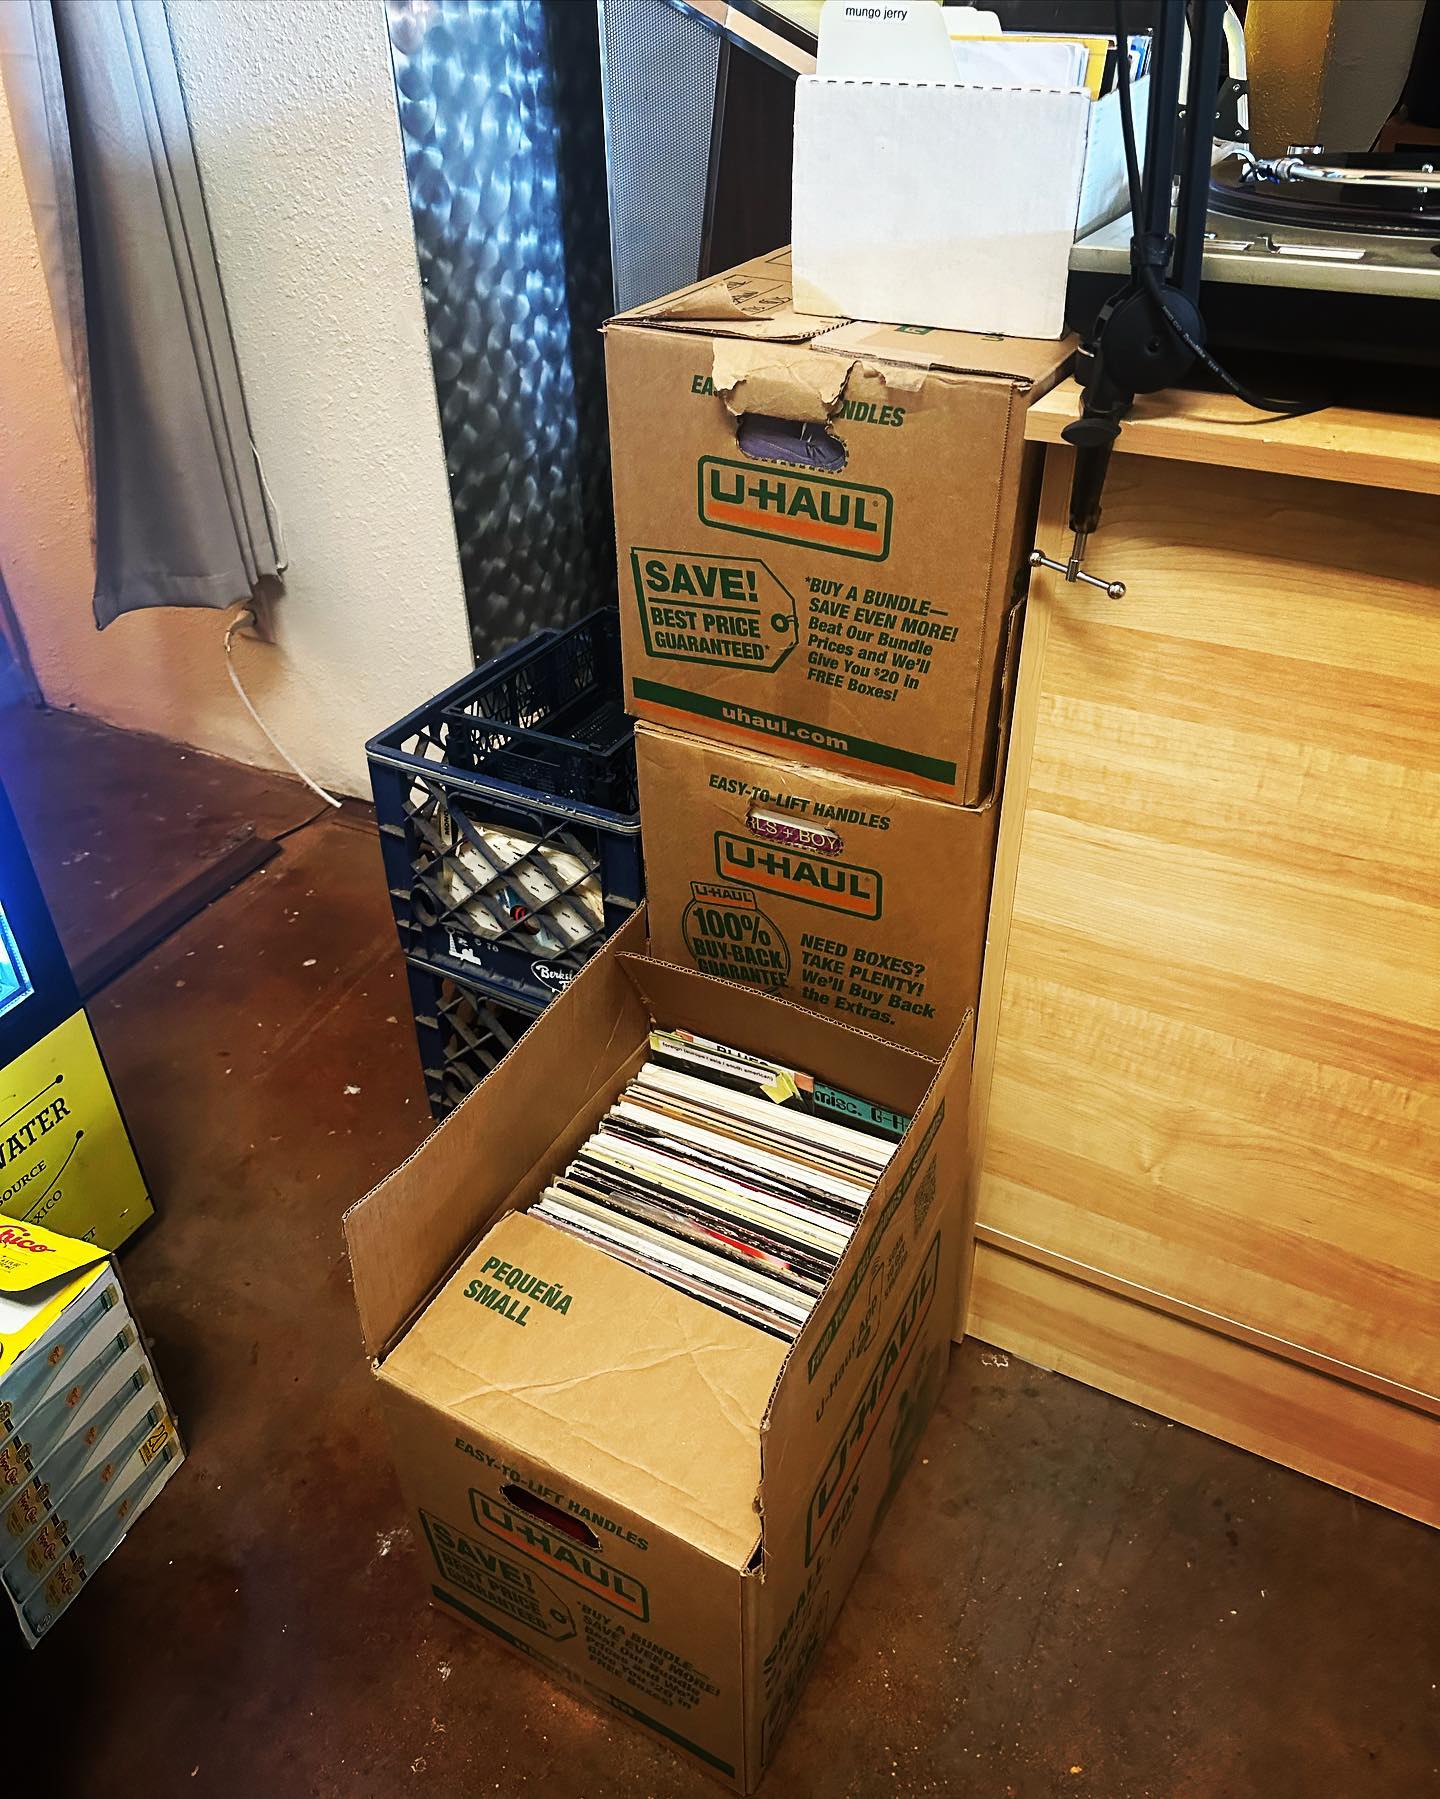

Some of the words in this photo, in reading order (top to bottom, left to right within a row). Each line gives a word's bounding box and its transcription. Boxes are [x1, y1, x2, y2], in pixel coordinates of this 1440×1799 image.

[845, 6, 881, 19] mungo
[884, 7, 908, 21] jerry
[840, 400, 906, 427] NDLES
[710, 470, 878, 532] U-HAUL
[646, 560, 759, 602] SAVE!
[846, 586, 858, 601] A
[651, 607, 697, 632] BEST
[702, 612, 761, 639] PRICE
[808, 617, 843, 637] Beat
[846, 624, 875, 644] Our
[878, 630, 933, 657] Bundle
[809, 599, 849, 620] SAVE
[852, 608, 897, 630] EVEN
[900, 616, 959, 643] MORE!
[807, 635, 855, 658] Prices
[857, 643, 888, 665] and
[891, 651, 931, 674] We'll
[807, 651, 840, 673] Give
[843, 660, 871, 678] You
[873, 666, 899, 684] $20
[902, 673, 919, 690] in
[806, 668, 844, 689] FREE
[846, 677, 898, 702] Boxes!
[722, 706, 849, 751] uhaul.com
[709, 774, 810, 813] EASY-TO-LIFT
[813, 802, 891, 831] HANDLES
[725, 840, 870, 898] U-HAUL
[692, 908, 771, 946] 100%
[692, 937, 784, 969] BUY-BACK
[800, 933, 848, 958] NEED
[852, 948, 926, 977] BOXES?
[801, 950, 844, 975] TAKE
[849, 962, 925, 997] PLENTY!
[801, 968, 844, 993] We'll
[849, 982, 883, 1007] Buy
[887, 994, 936, 1019] Back
[801, 985, 829, 1007] the
[834, 994, 896, 1025] Extras.
[814, 1089, 863, 1117] misc.
[27, 1189, 62, 1223] XICO
[463, 1279, 531, 1326] SMALL
[480, 1255, 574, 1316] PEQUEÑA
[147, 1423, 169, 1453] 20
[455, 1437, 564, 1509] EASY-TO-LIFT
[568, 1499, 648, 1551] HANDLES
[432, 1523, 536, 1594] SAVE!
[480, 1497, 637, 1602] U-HAUL
